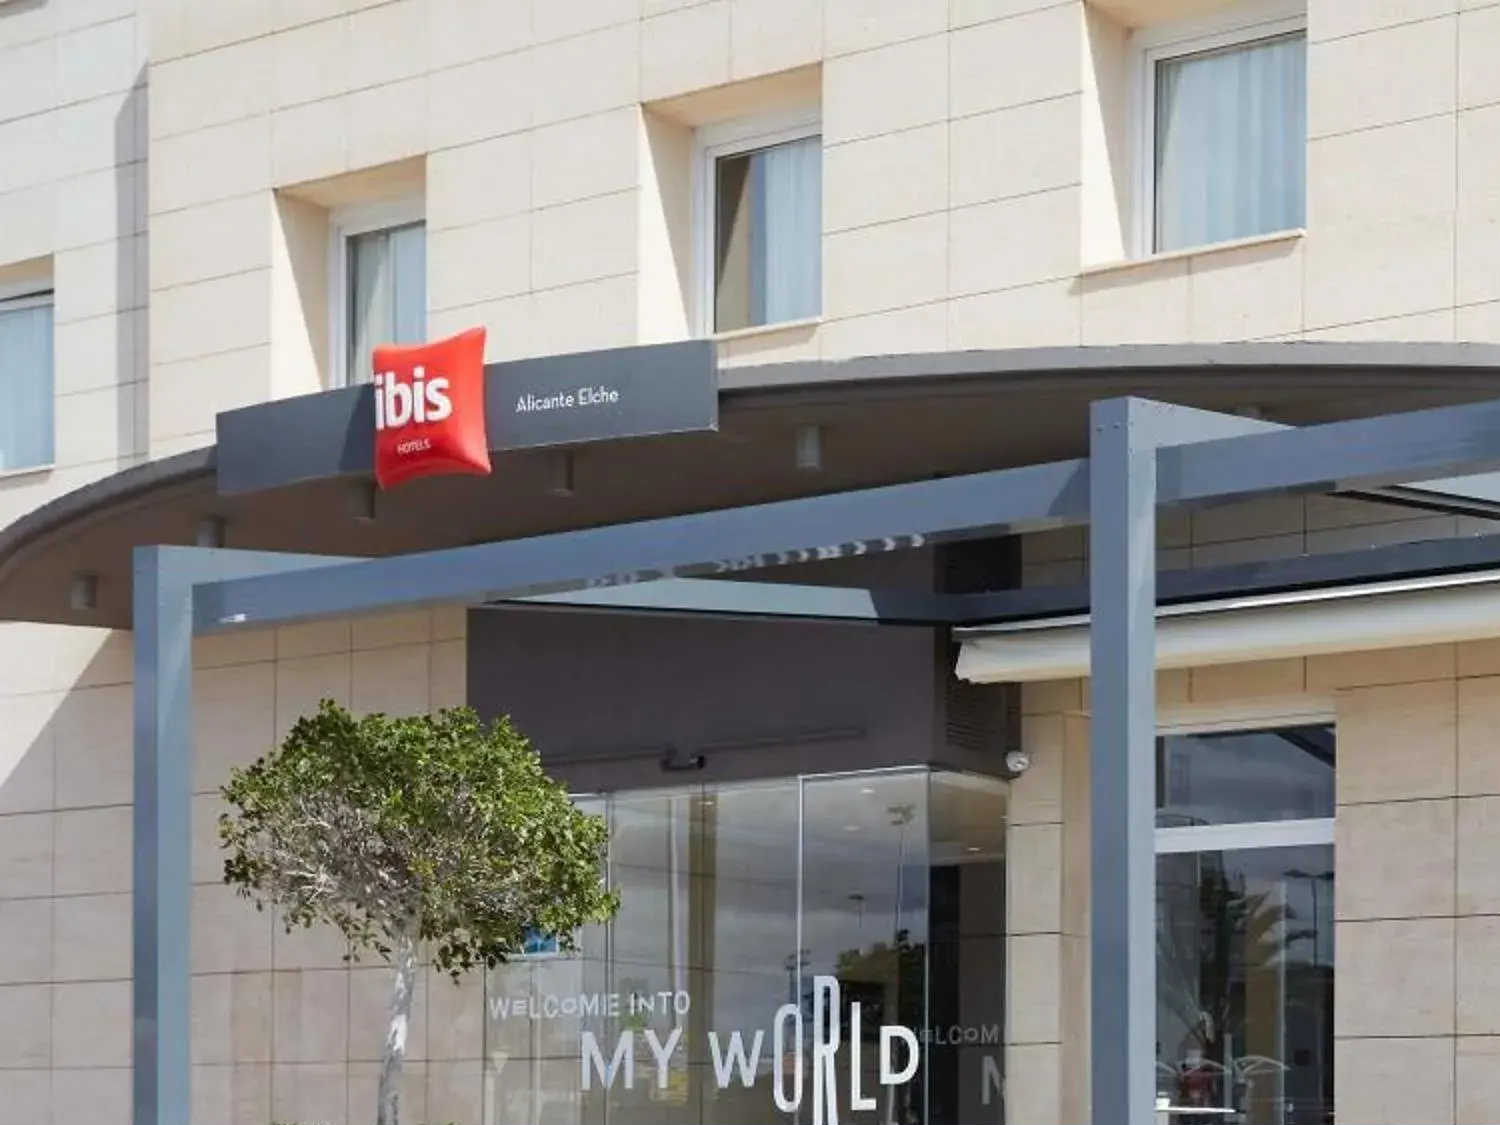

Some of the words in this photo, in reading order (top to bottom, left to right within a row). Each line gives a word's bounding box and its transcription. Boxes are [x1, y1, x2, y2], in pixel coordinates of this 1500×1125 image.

[374, 366, 453, 431] ibis
[516, 391, 575, 413] Alicante
[580, 386, 619, 405] Elche
[397, 438, 431, 455] HOTELS
[490, 994, 620, 1019] WELCOME
[629, 990, 691, 1015] INTO
[580, 1028, 683, 1091] MY
